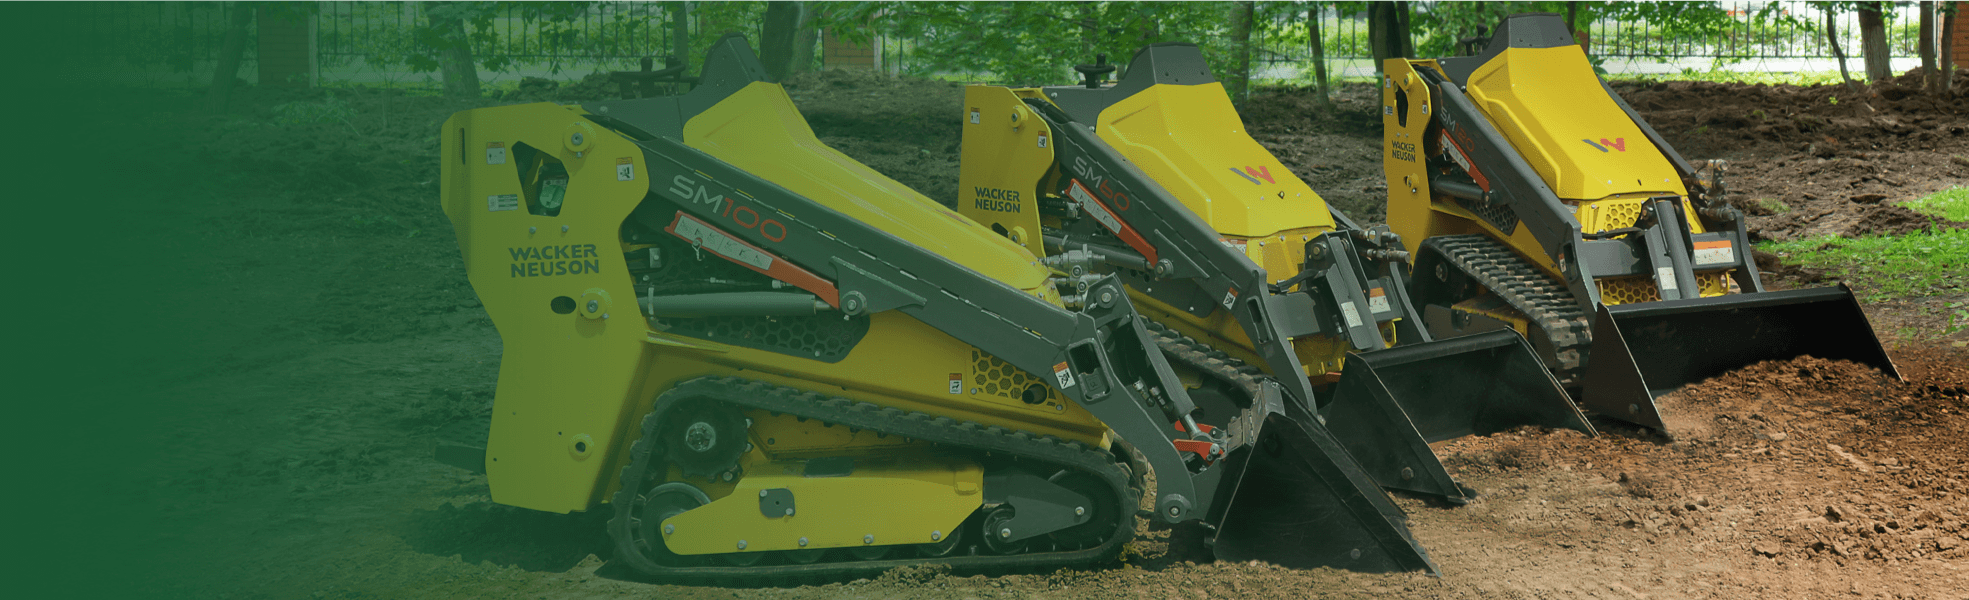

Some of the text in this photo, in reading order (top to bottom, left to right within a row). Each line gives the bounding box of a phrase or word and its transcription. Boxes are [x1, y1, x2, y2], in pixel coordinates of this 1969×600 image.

[1392, 140, 1416, 154] WACKER
[1392, 148, 1416, 163] NEUSON
[1073, 156, 1130, 211] SM60
[974, 186, 1020, 203] WACKER
[669, 174, 787, 242] SM100
[975, 198, 1020, 214] NEUSON
[508, 244, 598, 261] WACKER
[511, 259, 599, 278] NEUSON
